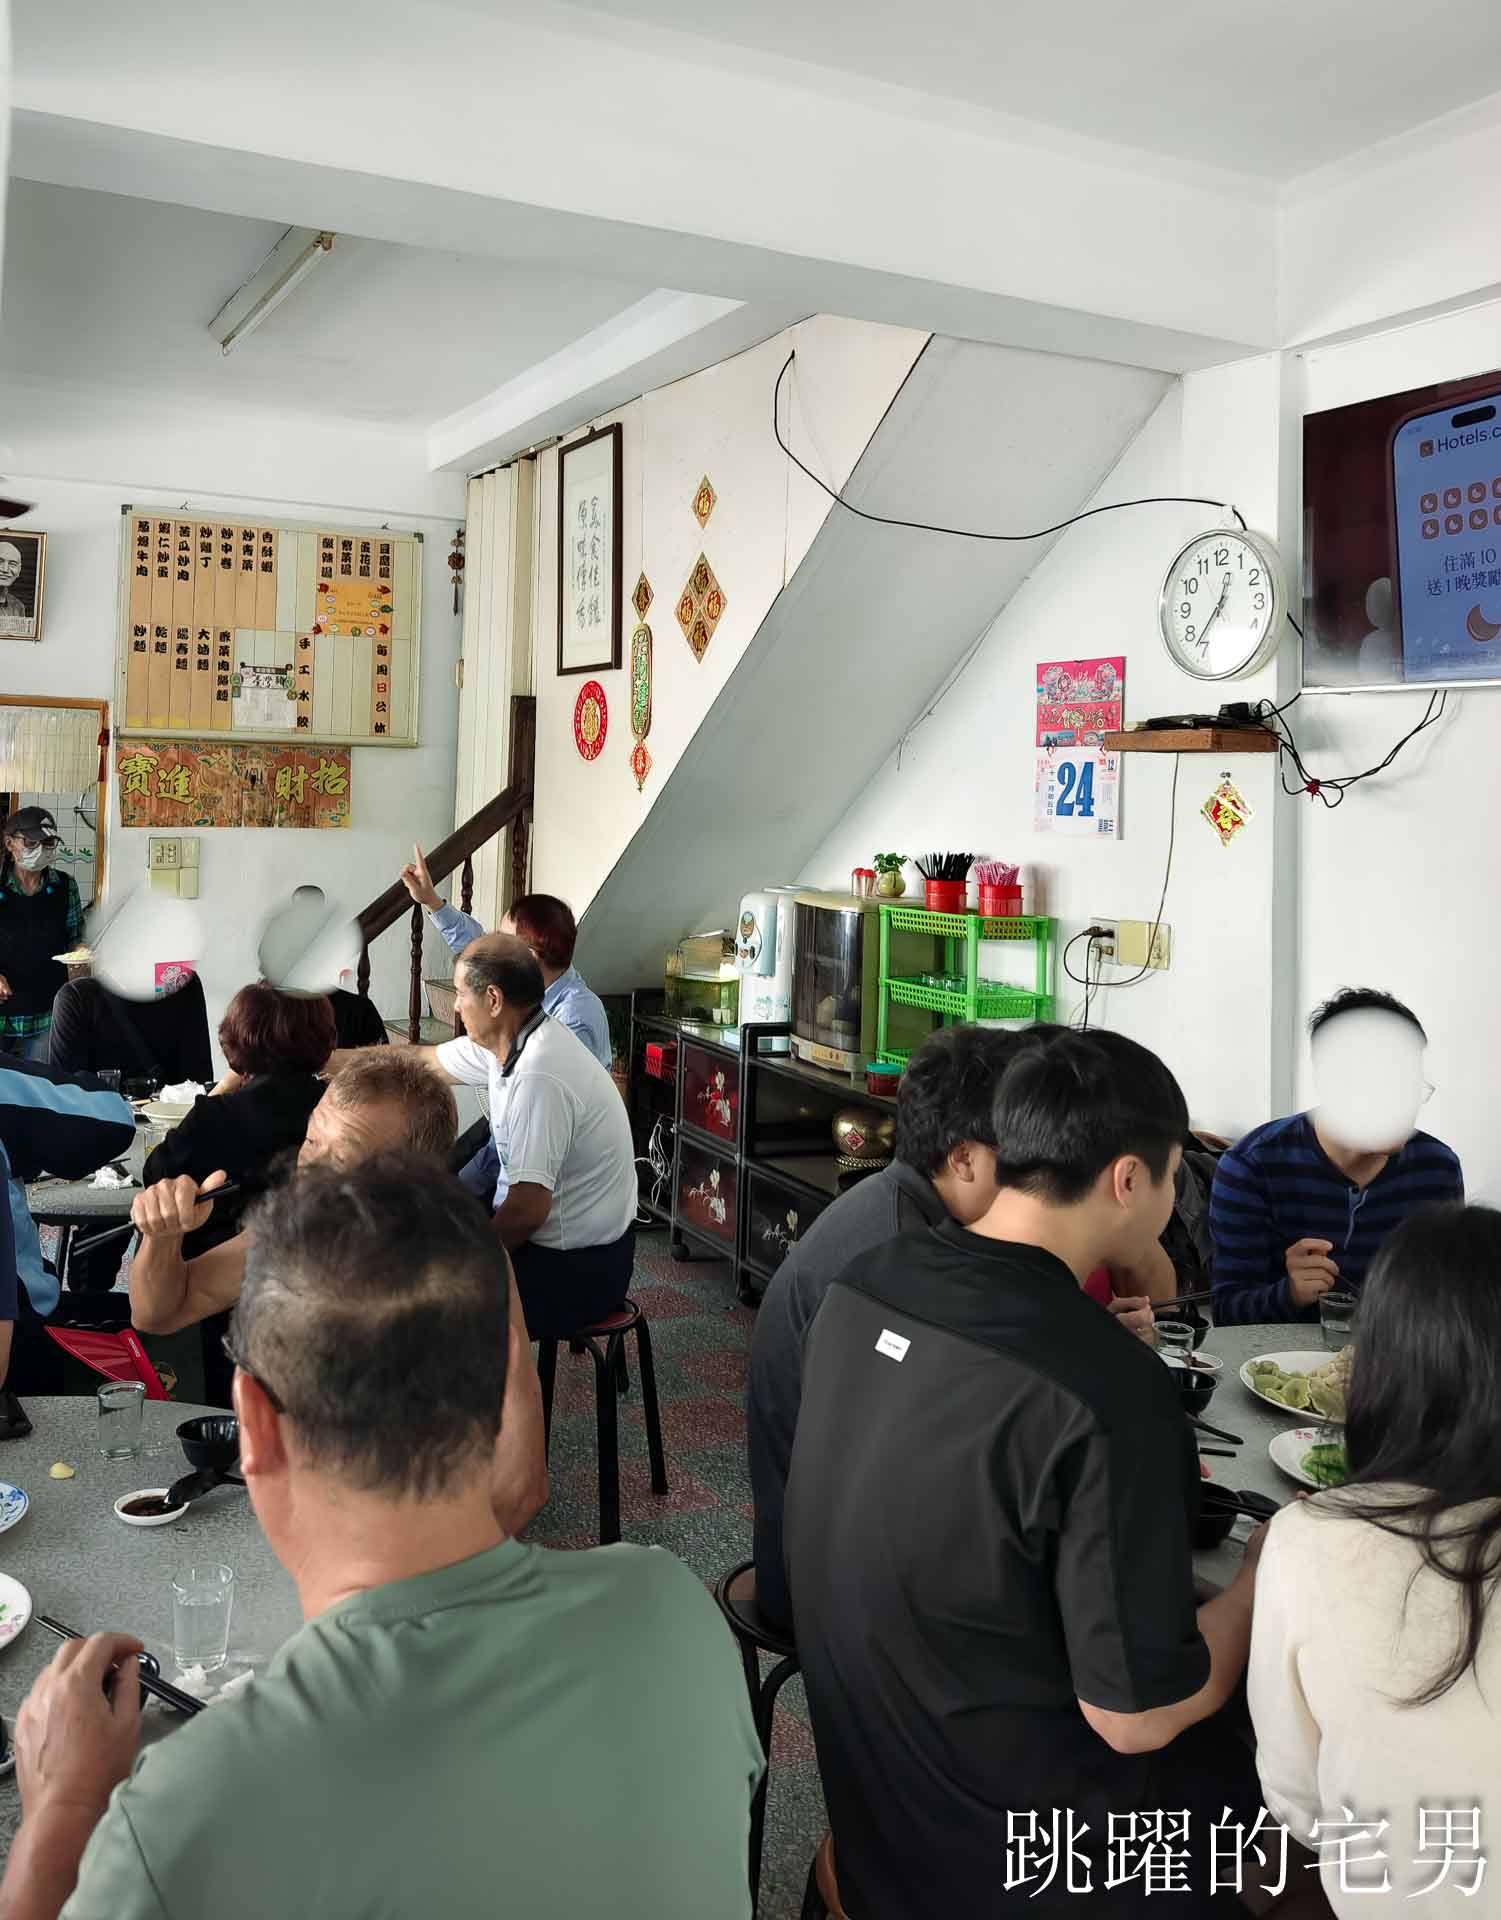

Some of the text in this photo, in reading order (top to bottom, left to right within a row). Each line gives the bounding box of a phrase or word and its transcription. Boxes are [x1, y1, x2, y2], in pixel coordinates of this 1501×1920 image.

[177, 526, 191, 582] 苦瓜炒肉
[241, 529, 255, 572] 炒青菜
[1214, 548, 1230, 566] 12
[1197, 559, 1209, 575] 11
[1237, 553, 1244, 569] 1
[1444, 548, 1497, 574] 住滿 10
[1183, 577, 1198, 595] 10
[1249, 569, 1260, 586] 2
[1180, 602, 1191, 619] 9
[1254, 593, 1265, 610] 3
[133, 624, 147, 653] 炒麵
[1185, 625, 1196, 642] 8
[1200, 641, 1210, 658] 7
[297, 637, 311, 728] 手工水餃
[1055, 761, 1095, 817] 24
